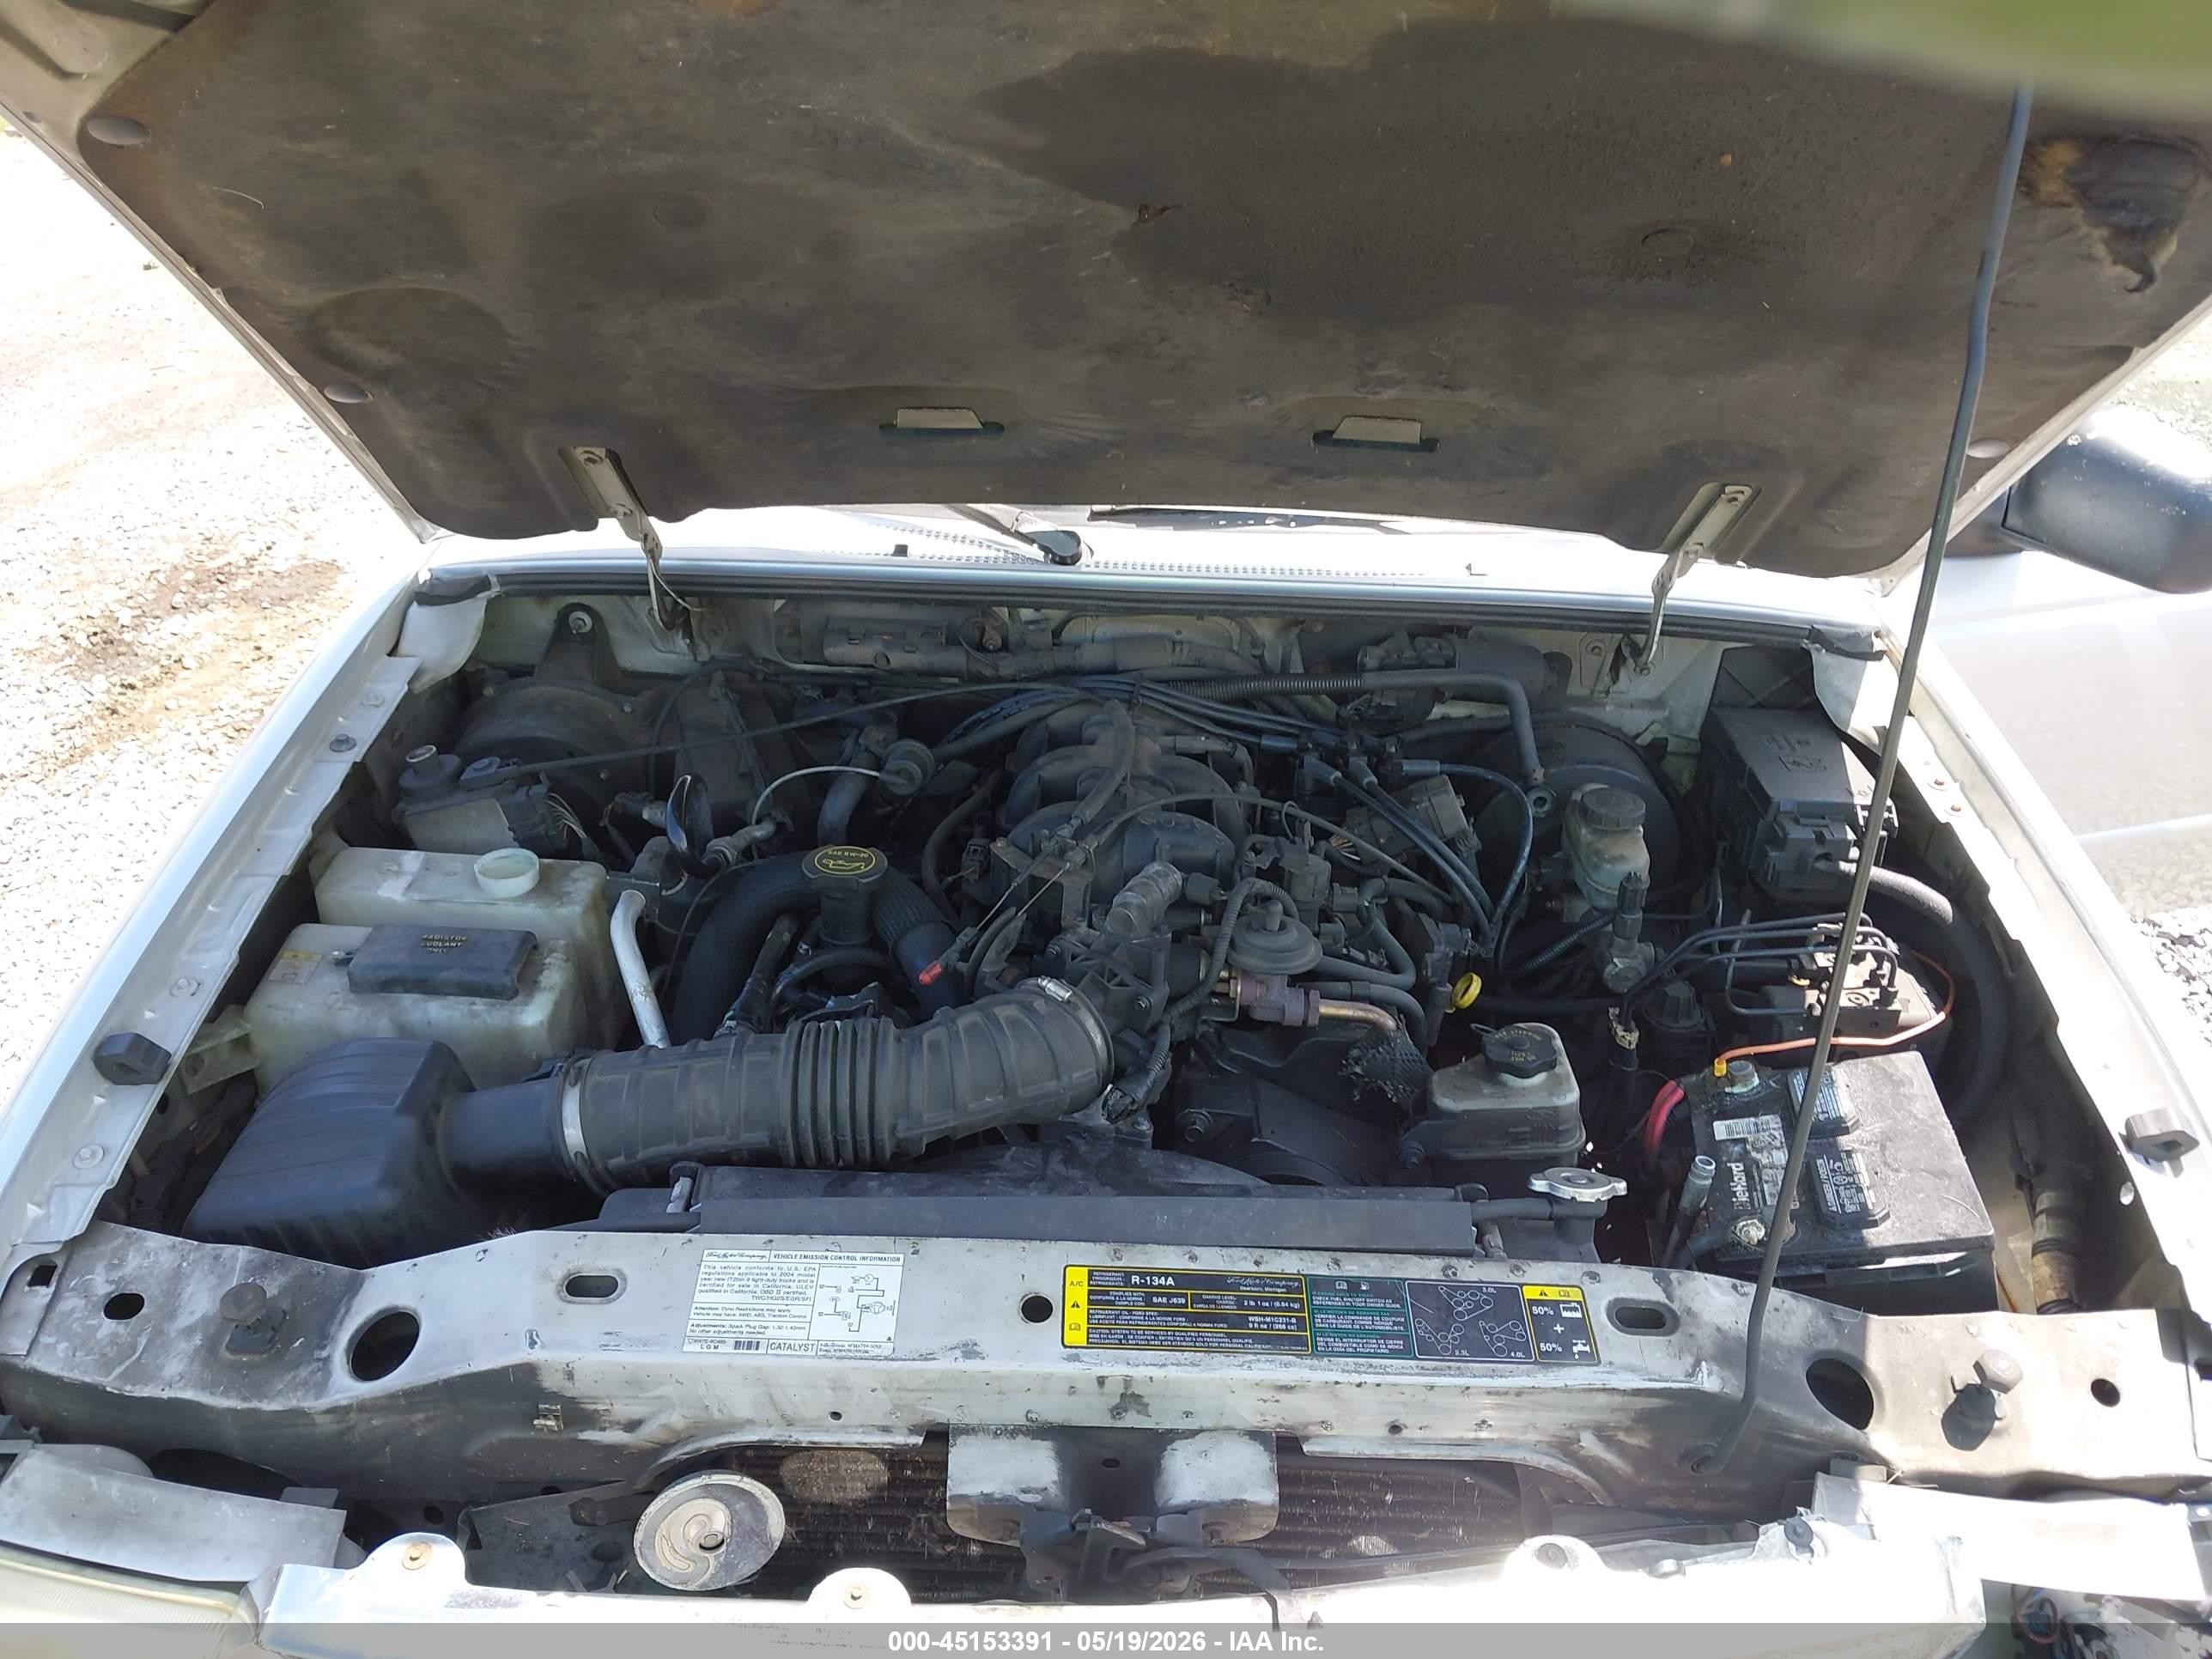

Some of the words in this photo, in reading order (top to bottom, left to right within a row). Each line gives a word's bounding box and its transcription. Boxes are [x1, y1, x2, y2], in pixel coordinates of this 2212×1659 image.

[1131, 1275, 1176, 1287] R-134A
[1531, 1305, 1554, 1316] 50%
[769, 1341, 816, 1352] CATALYST
[1539, 1342, 1563, 1352] 50%
